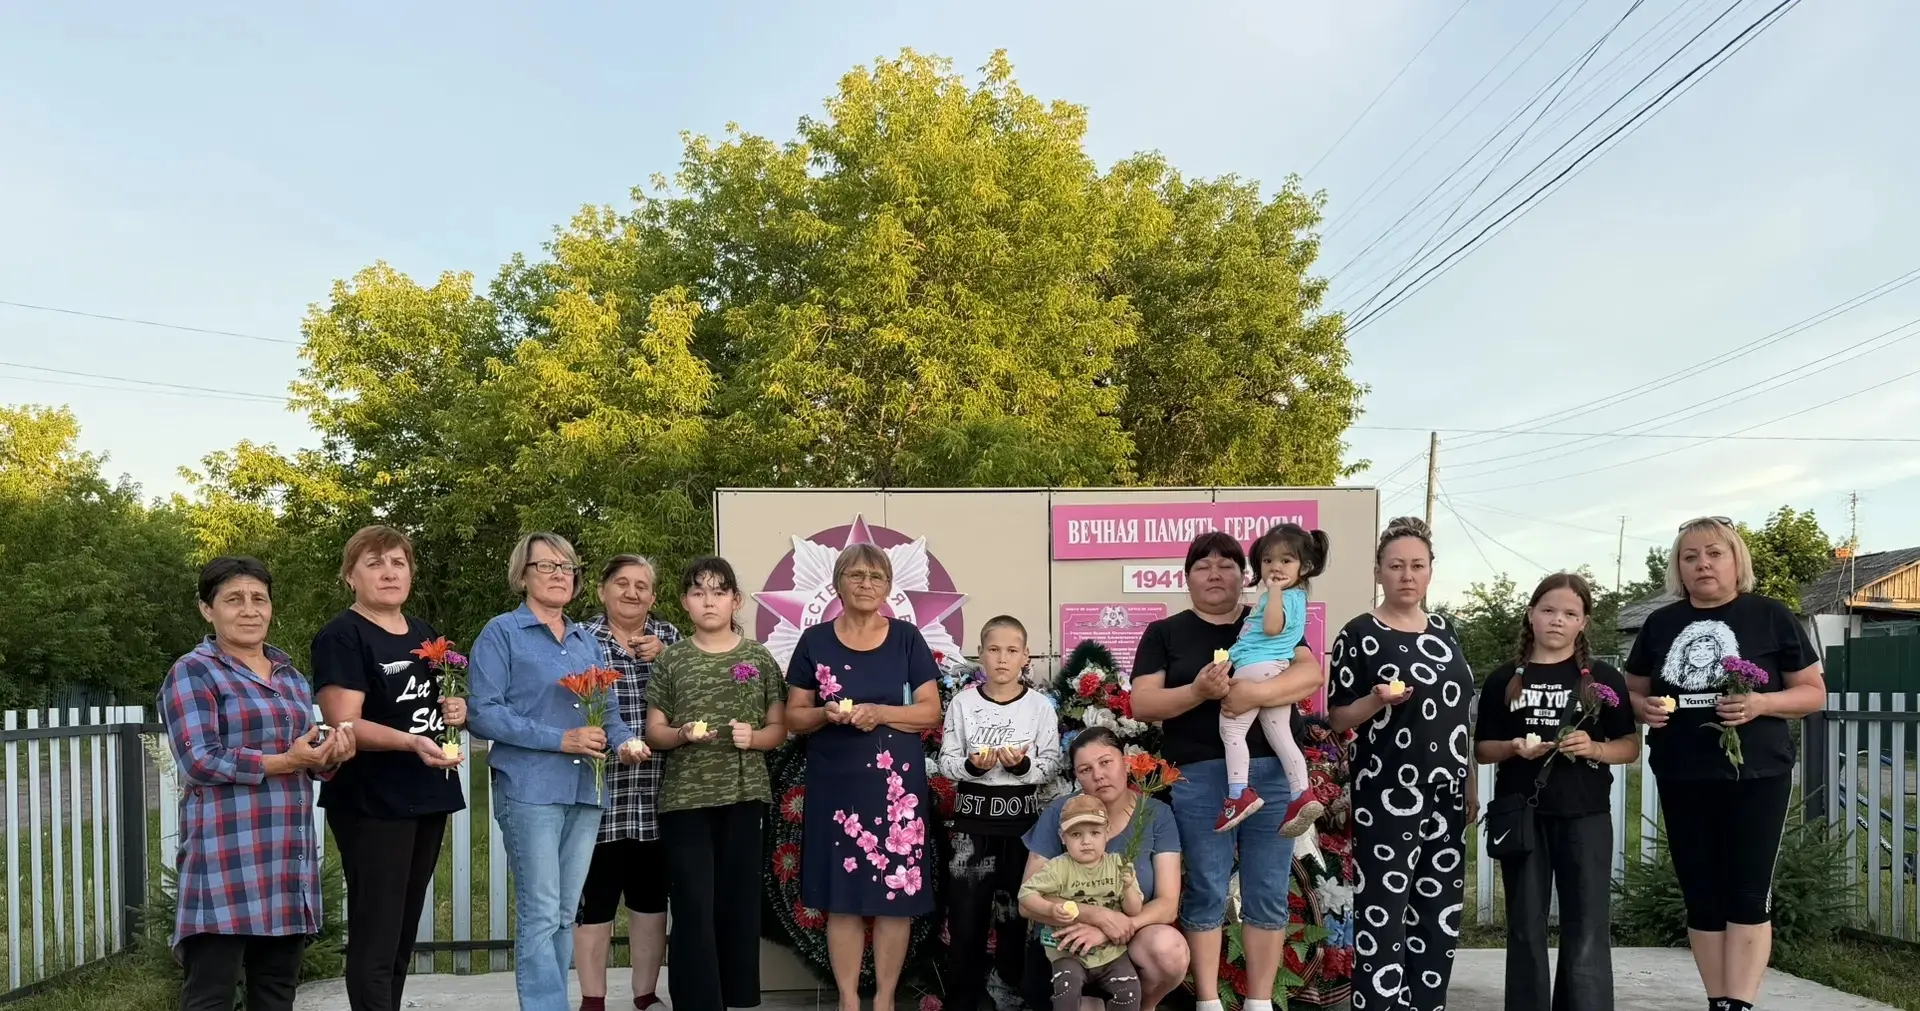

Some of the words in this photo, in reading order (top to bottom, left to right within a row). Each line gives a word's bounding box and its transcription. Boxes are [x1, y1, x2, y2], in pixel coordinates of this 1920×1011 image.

[1067, 518, 1139, 544] ВЕЧНАЯ
[1144, 517, 1219, 543] ПАМЯТЬ
[1224, 515, 1304, 541] ГЕРО
[395, 675, 431, 703] Let
[409, 707, 445, 734] Sle
[1540, 718, 1561, 726] YOUN
[971, 727, 1015, 746] NIKE
[954, 793, 986, 815] UST
[989, 797, 1022, 816] DO
